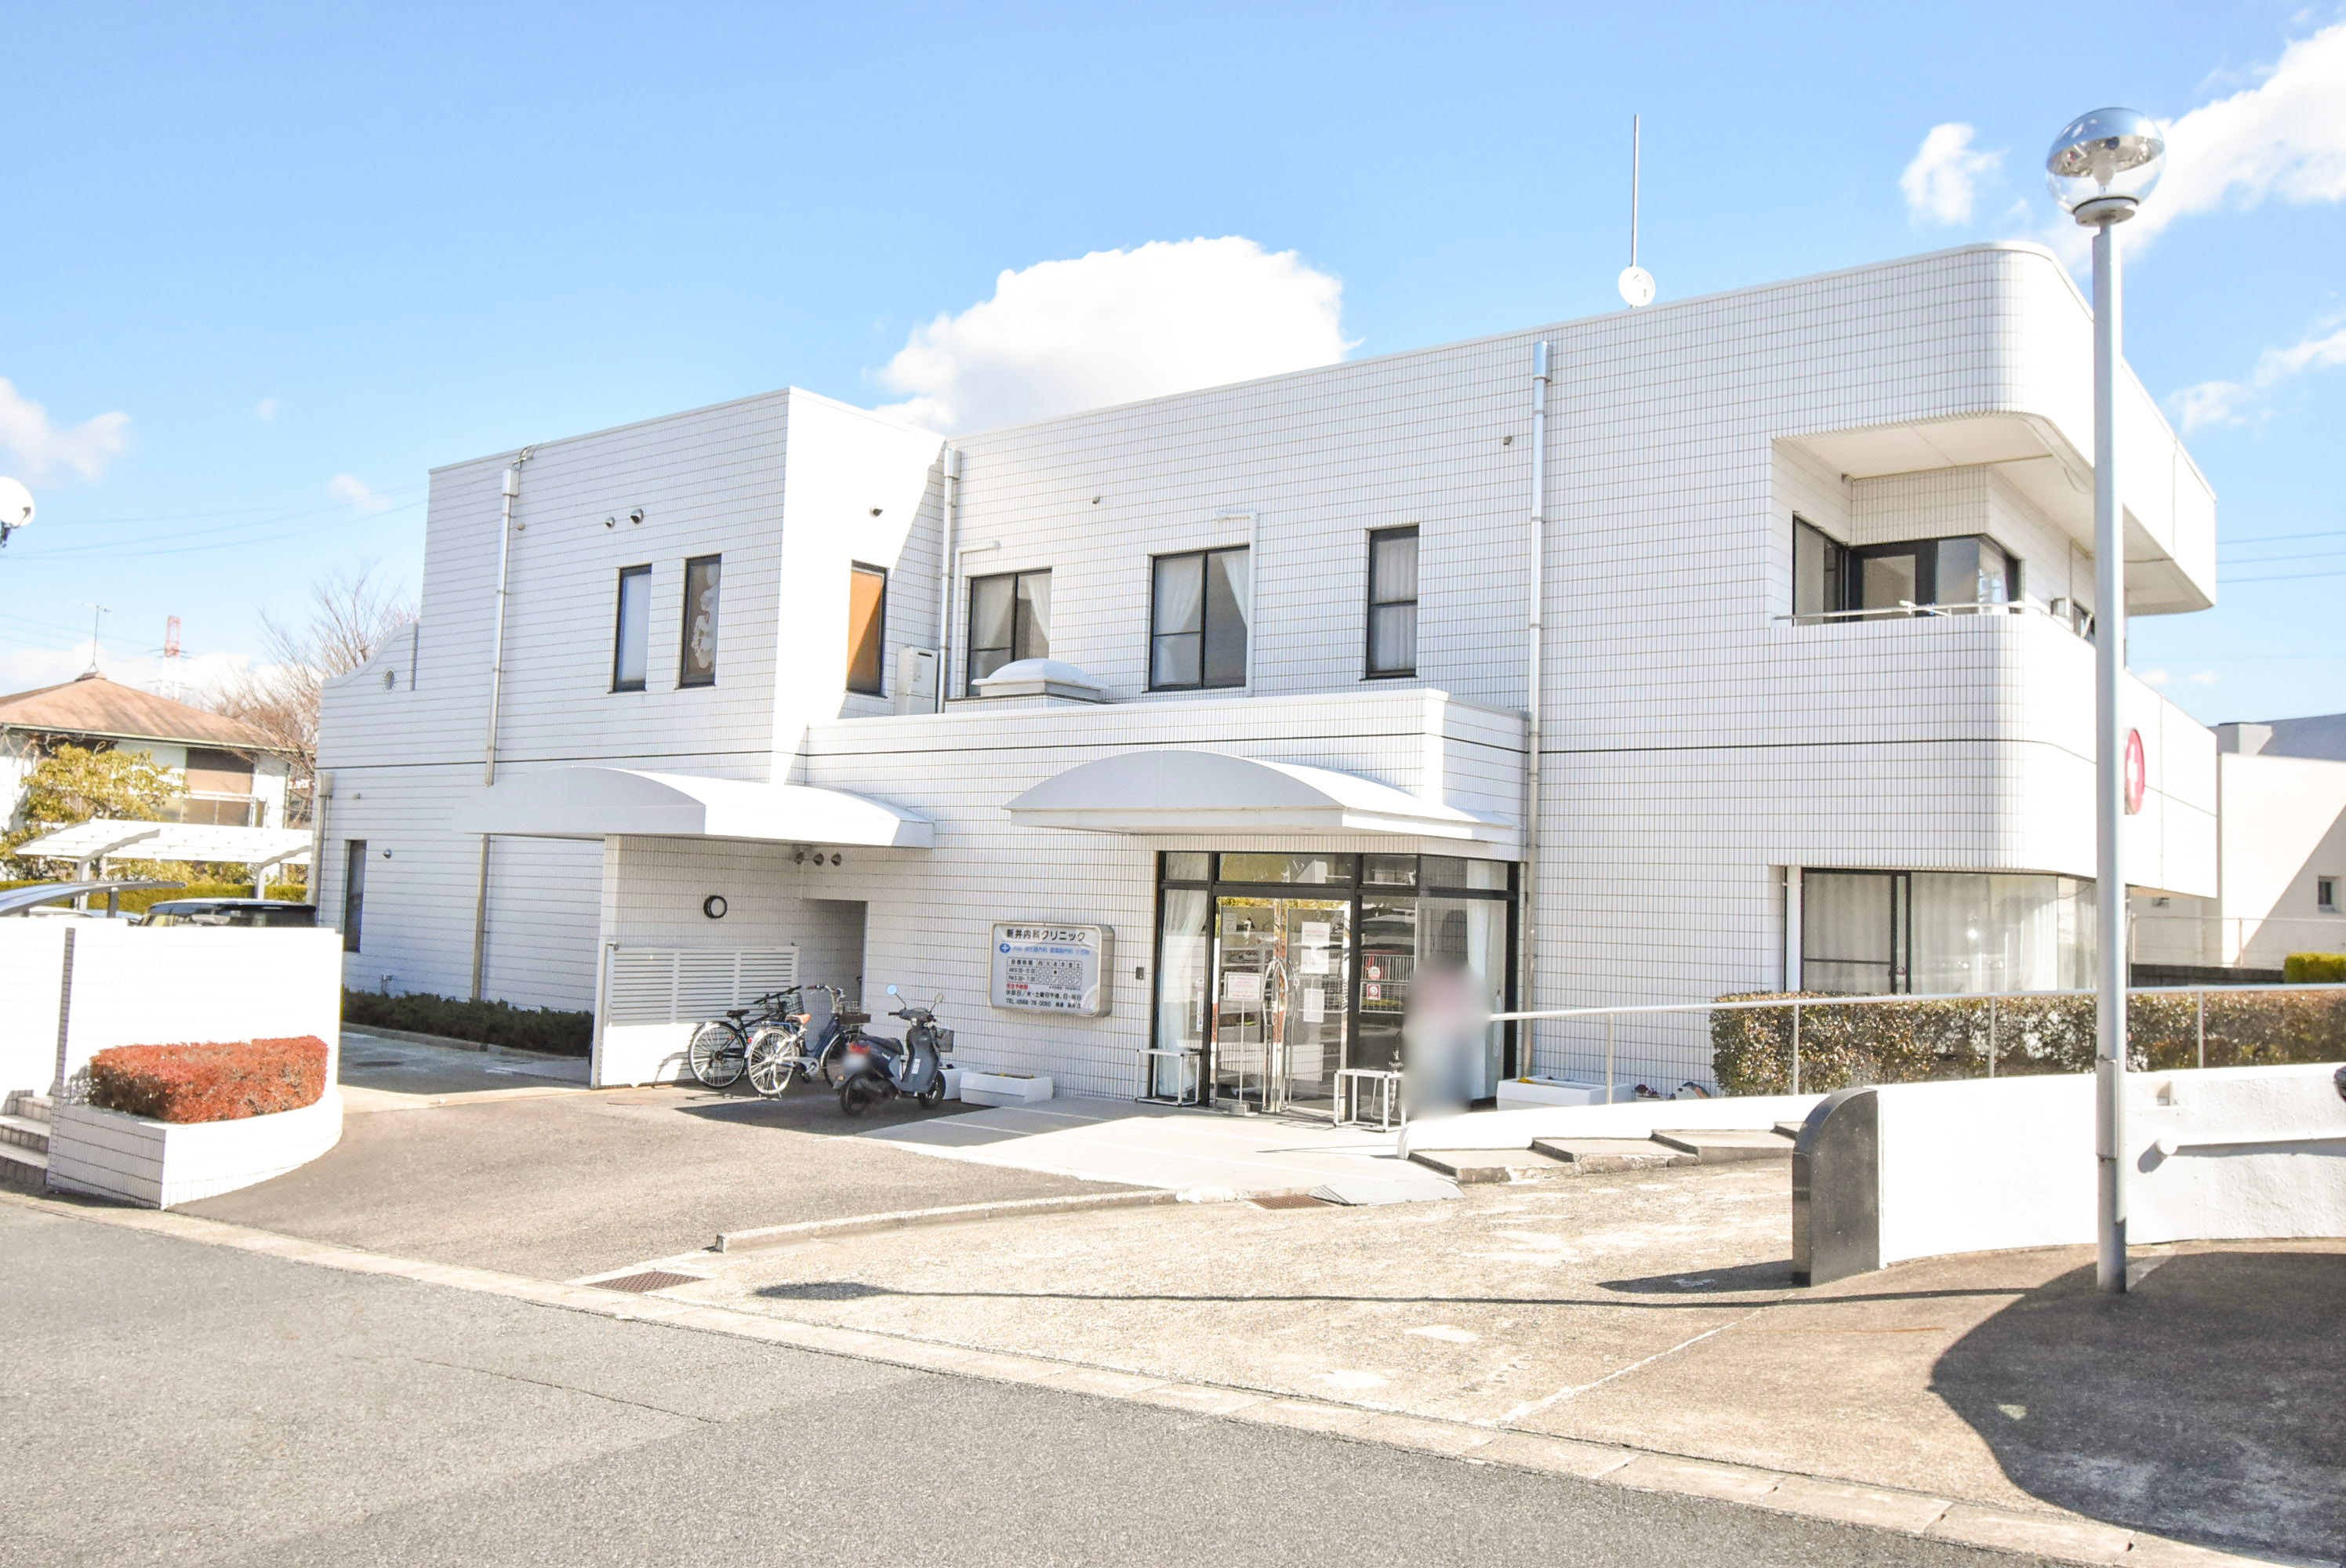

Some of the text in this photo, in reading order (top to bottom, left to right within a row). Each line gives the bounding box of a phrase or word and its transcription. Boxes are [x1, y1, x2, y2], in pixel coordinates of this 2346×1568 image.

[1007, 928, 1085, 942] 新井内科クリニック
